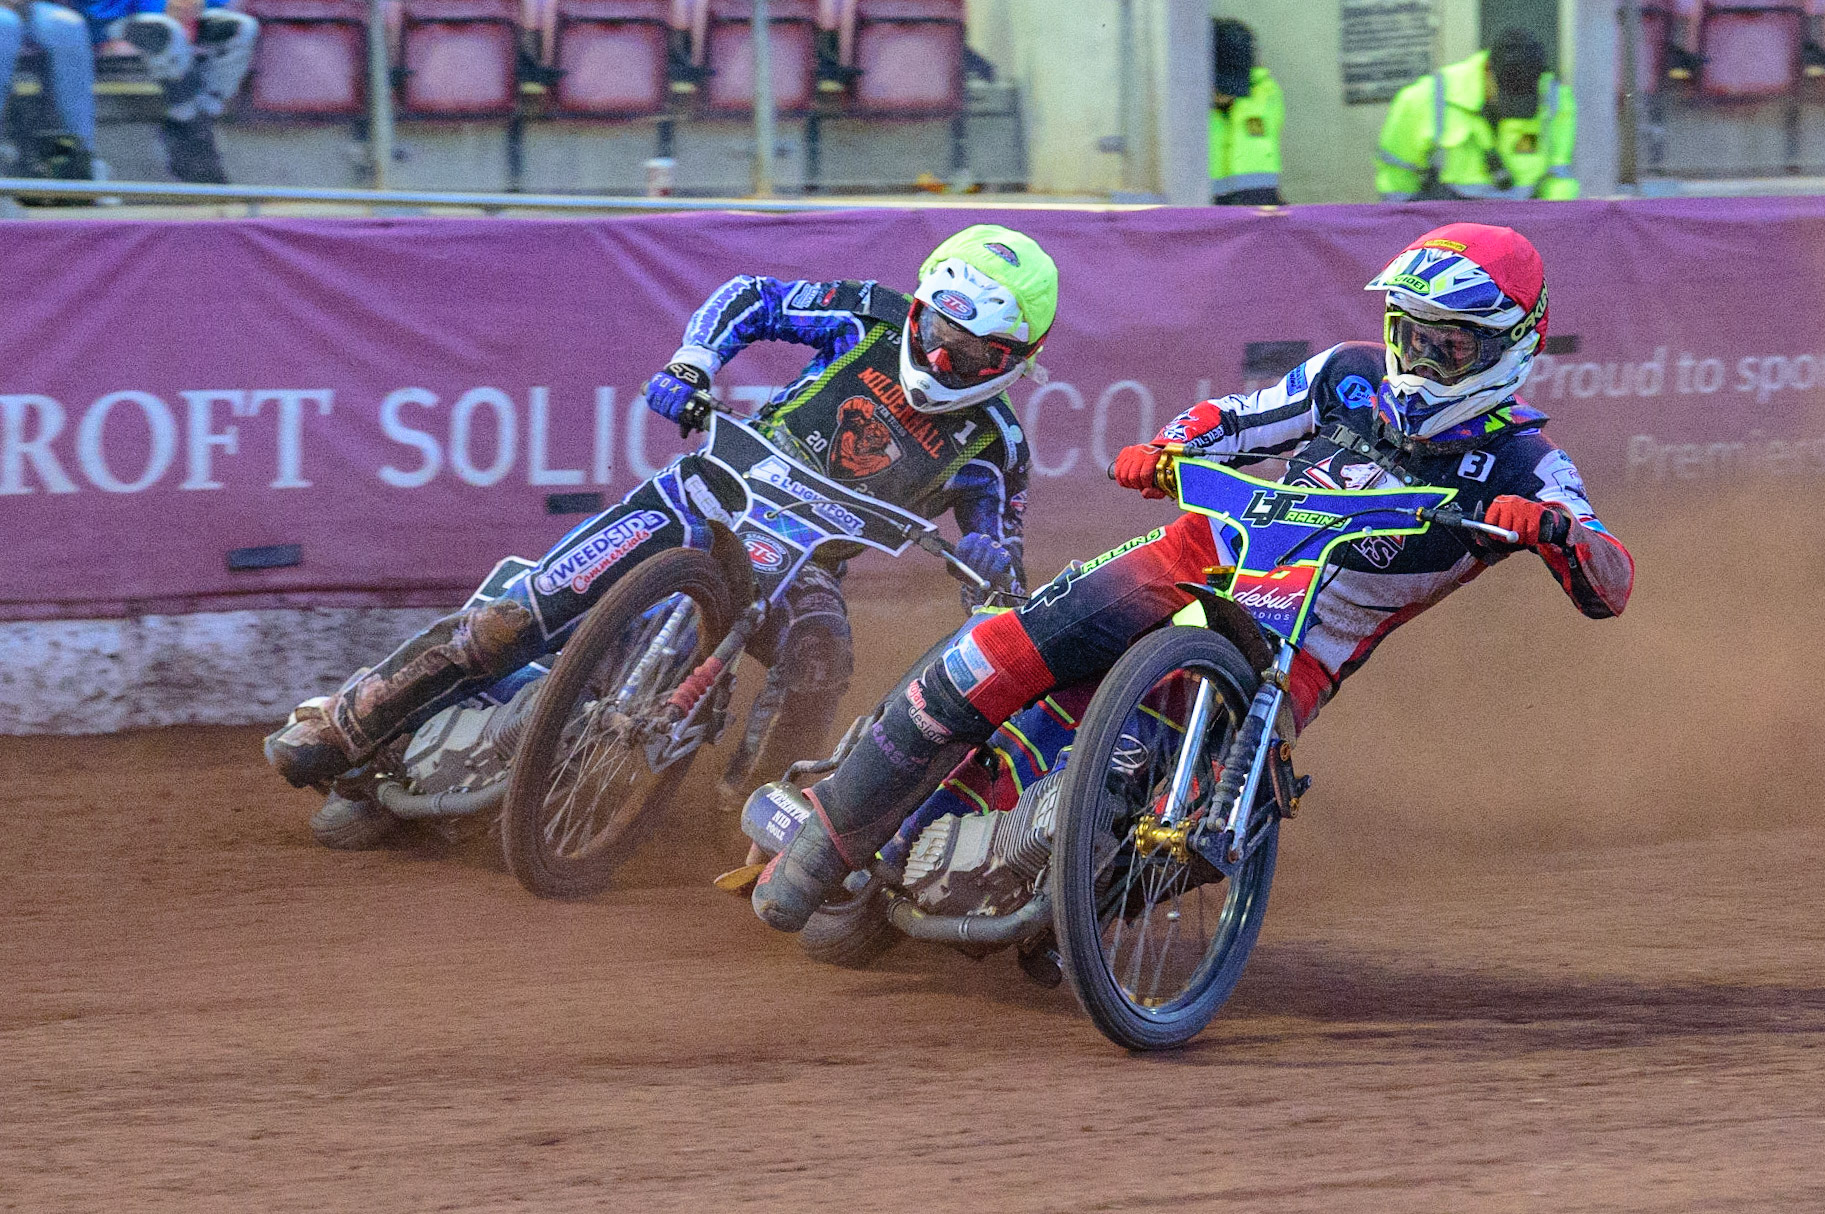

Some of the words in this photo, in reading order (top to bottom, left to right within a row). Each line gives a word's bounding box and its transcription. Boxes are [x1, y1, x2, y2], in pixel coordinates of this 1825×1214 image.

[941, 294, 968, 313] STS
[651, 374, 684, 394] FOX
[1527, 349, 1667, 398] Proud
[1676, 353, 1726, 393] to
[1734, 353, 1825, 403] spo
[0, 388, 334, 496] ROFT
[805, 430, 829, 453] 20
[953, 419, 977, 446] 1
[1462, 451, 1489, 479] 3
[791, 483, 862, 531] LIGHTFOOT
[1284, 510, 1345, 529] RACING
[546, 511, 661, 587] TWEEDSIDE
[571, 528, 652, 593] Commercials
[745, 541, 780, 564] STS
[1080, 528, 1162, 576] RACING
[1253, 610, 1291, 622] DIOS
